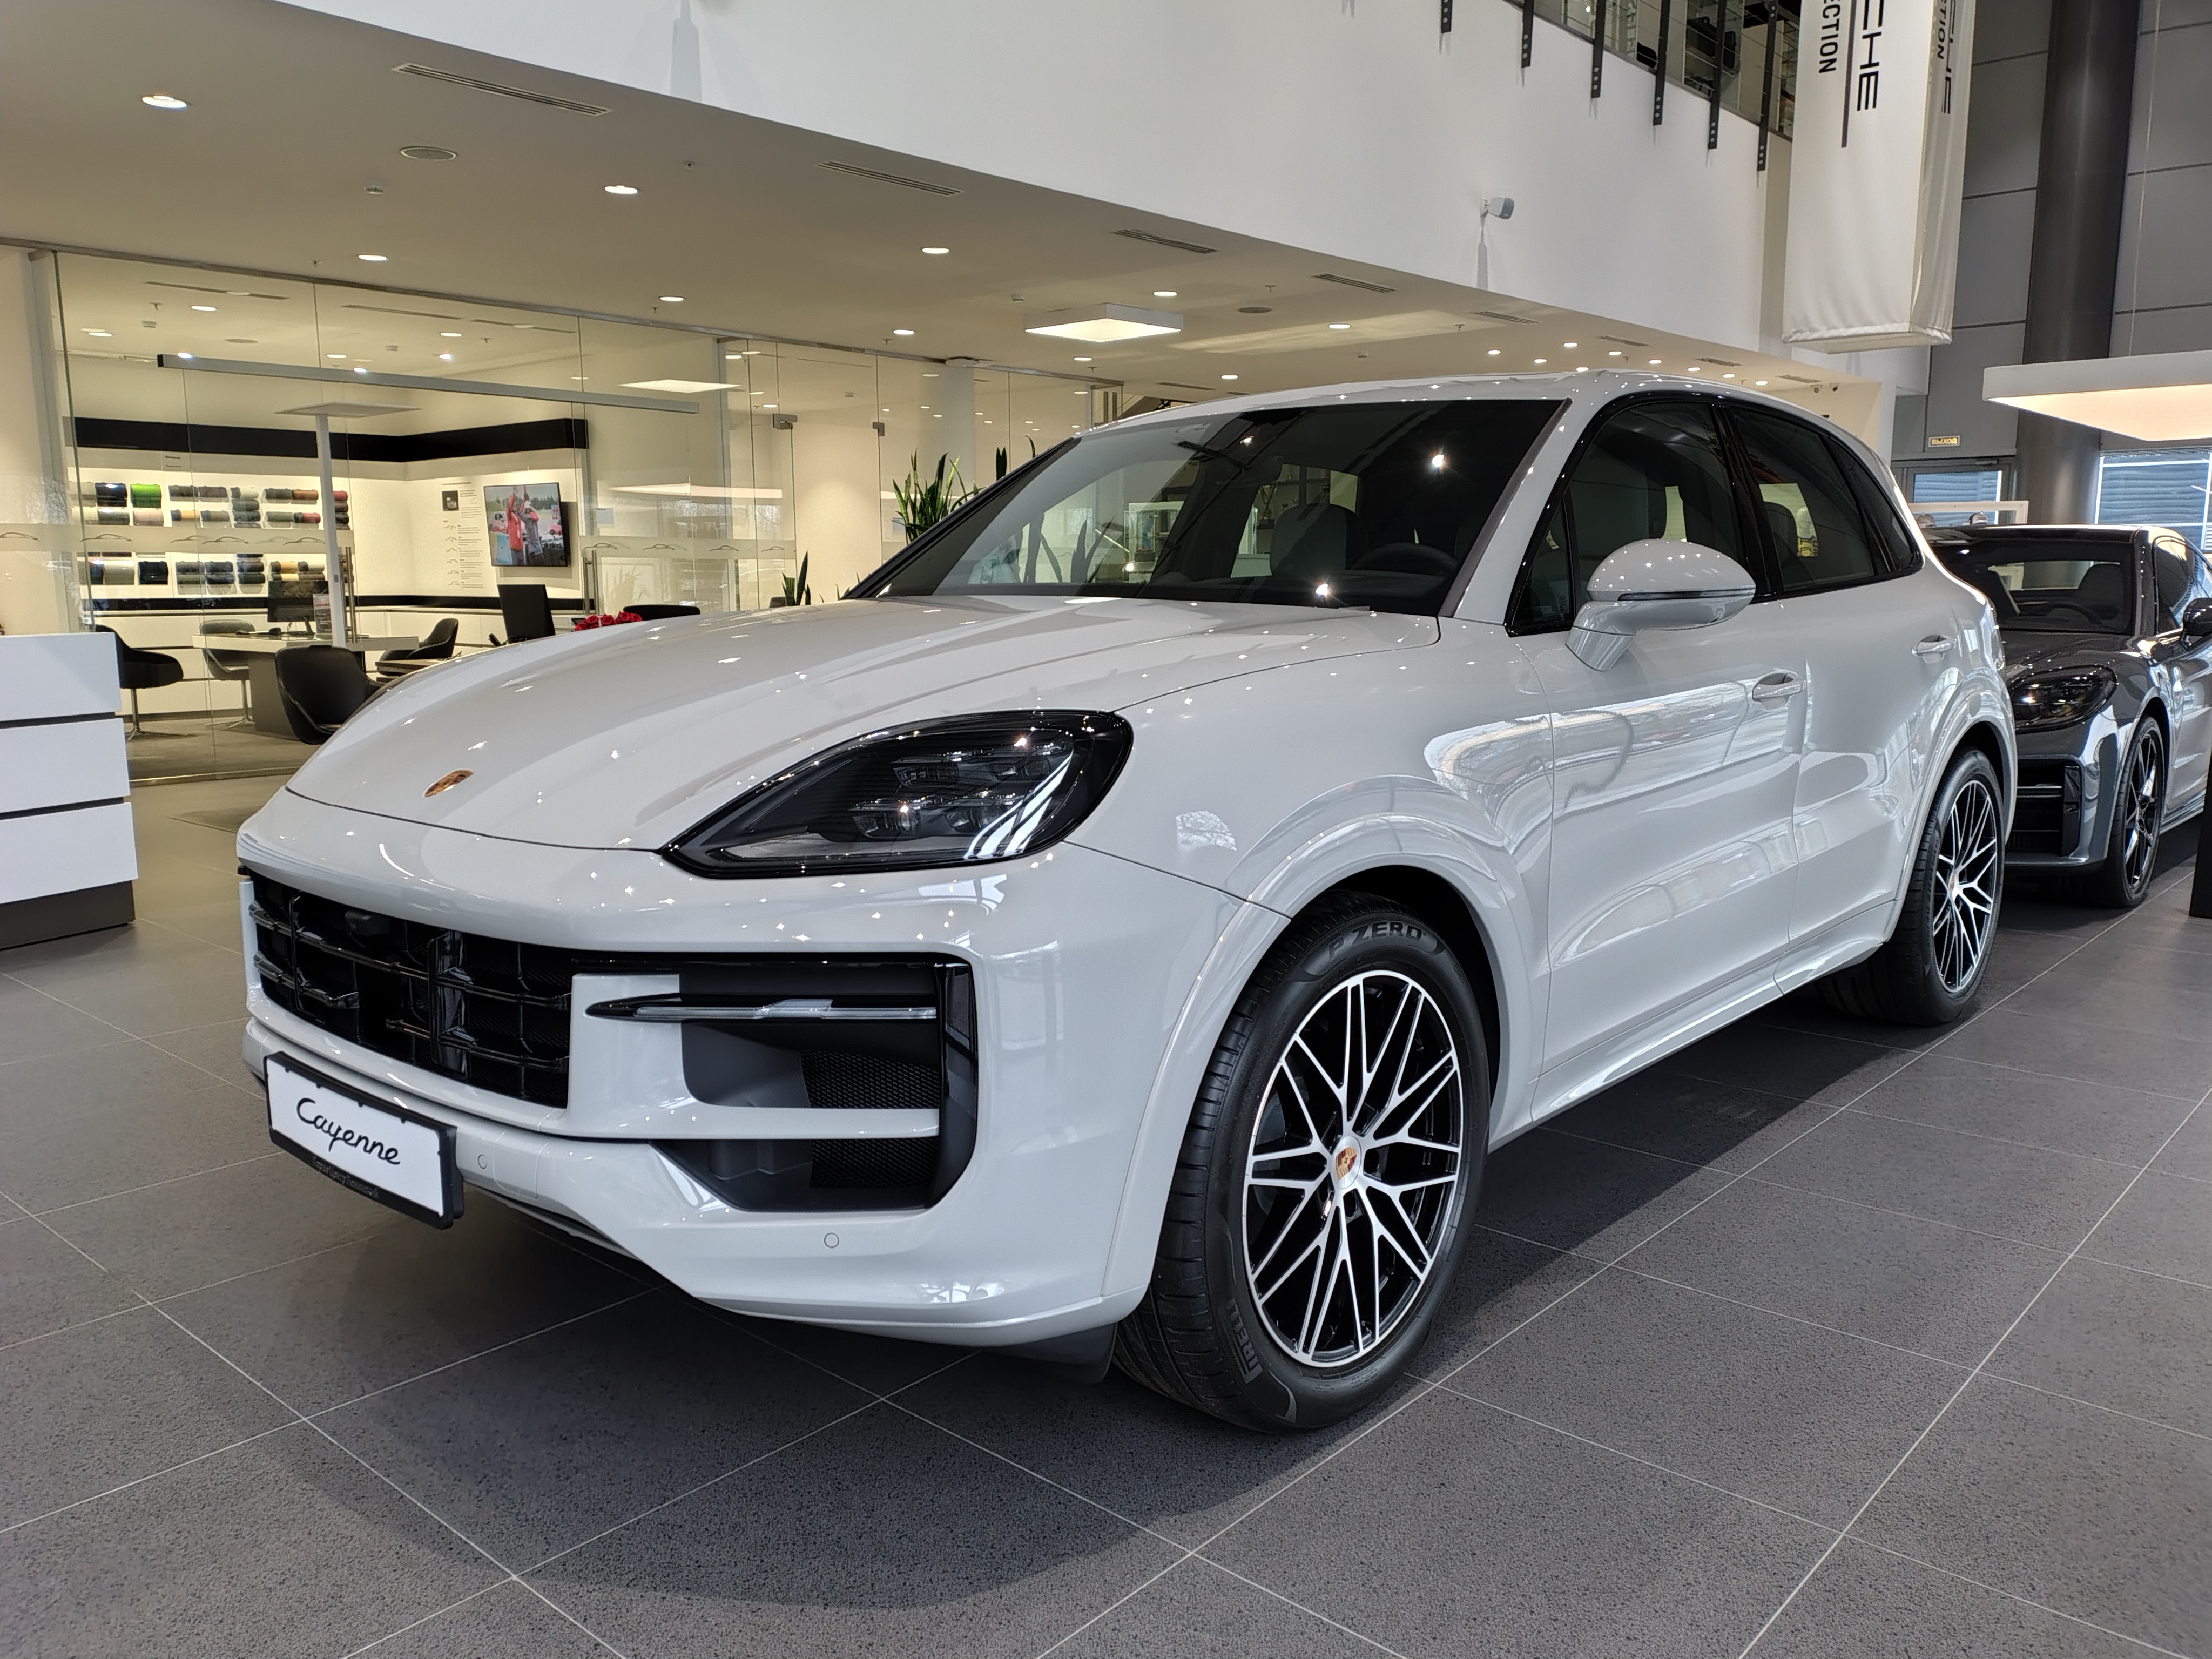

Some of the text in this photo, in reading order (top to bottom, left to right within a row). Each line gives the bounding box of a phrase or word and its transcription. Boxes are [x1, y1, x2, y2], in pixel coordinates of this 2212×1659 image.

[1818, 0, 1840, 73] CTION
[1937, 0, 1947, 59] TION
[1328, 921, 1423, 959] P ZERO
[296, 1097, 401, 1165] Cayenne
